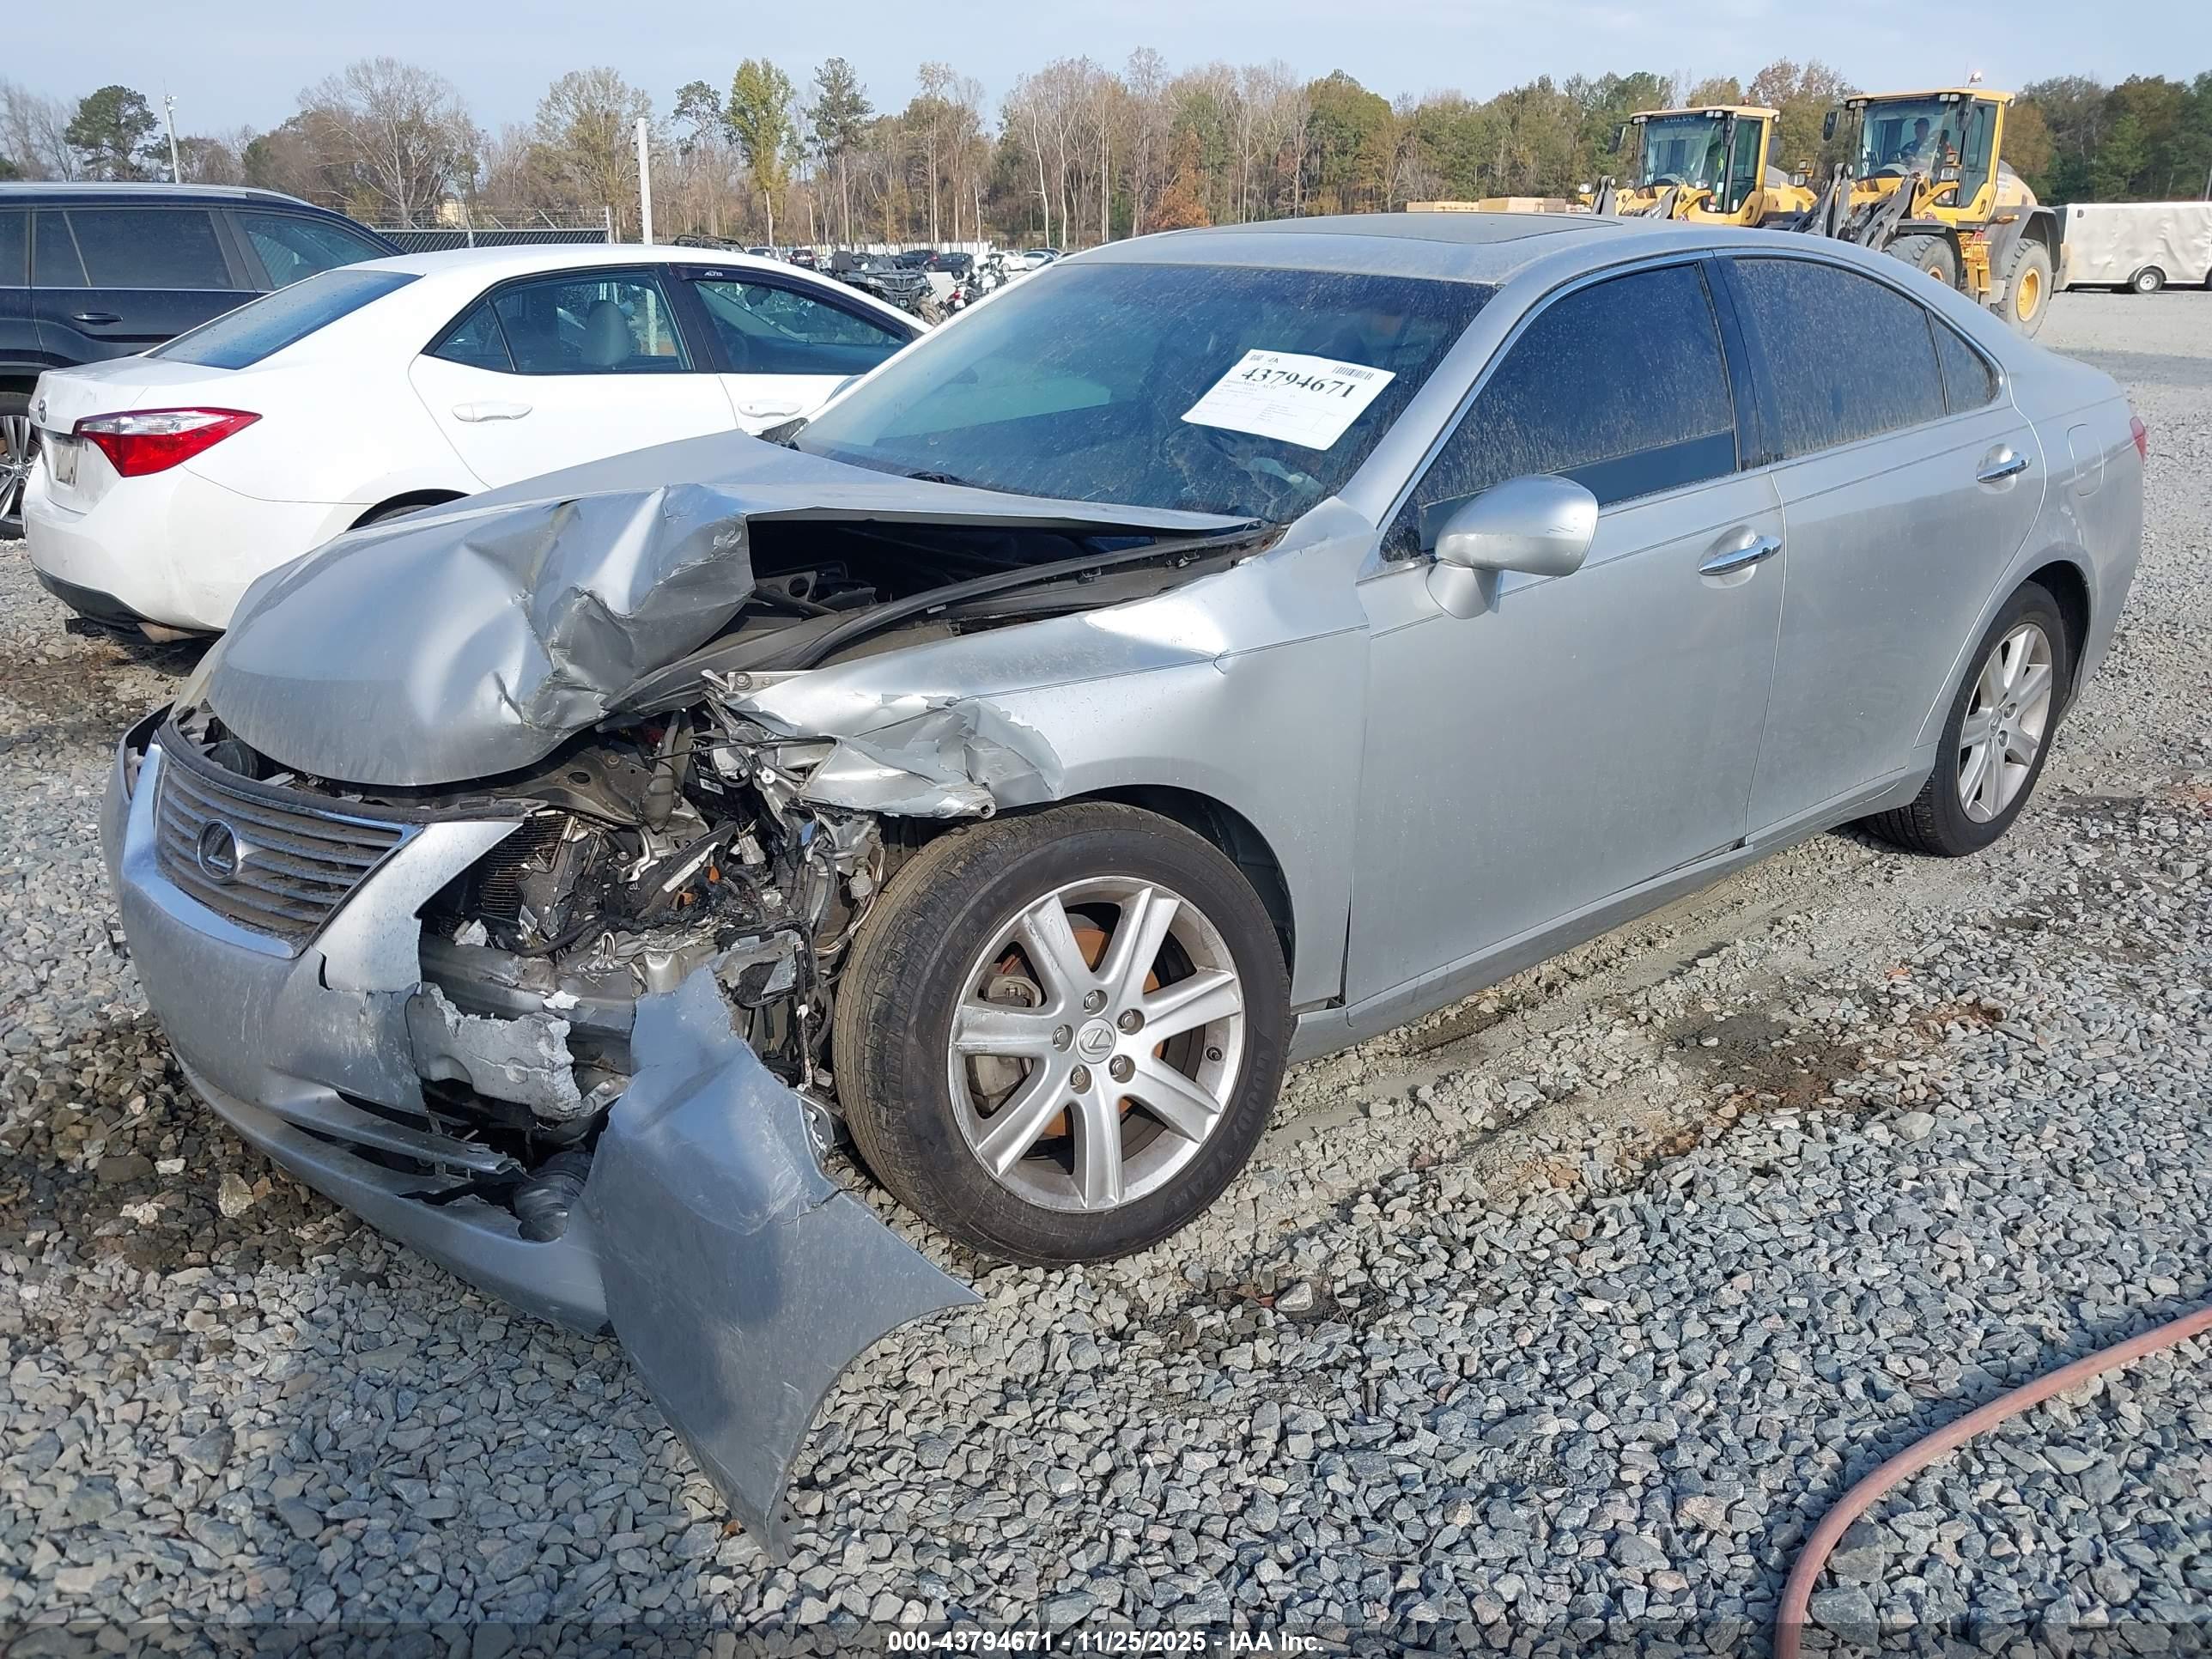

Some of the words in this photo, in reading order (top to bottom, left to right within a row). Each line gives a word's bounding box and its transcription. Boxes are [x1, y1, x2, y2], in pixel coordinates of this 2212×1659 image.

[1662, 115, 1696, 124] VOLVO
[1241, 367, 1357, 399] 43794671
[1169, 1048, 1273, 1209] GOODYEAR
